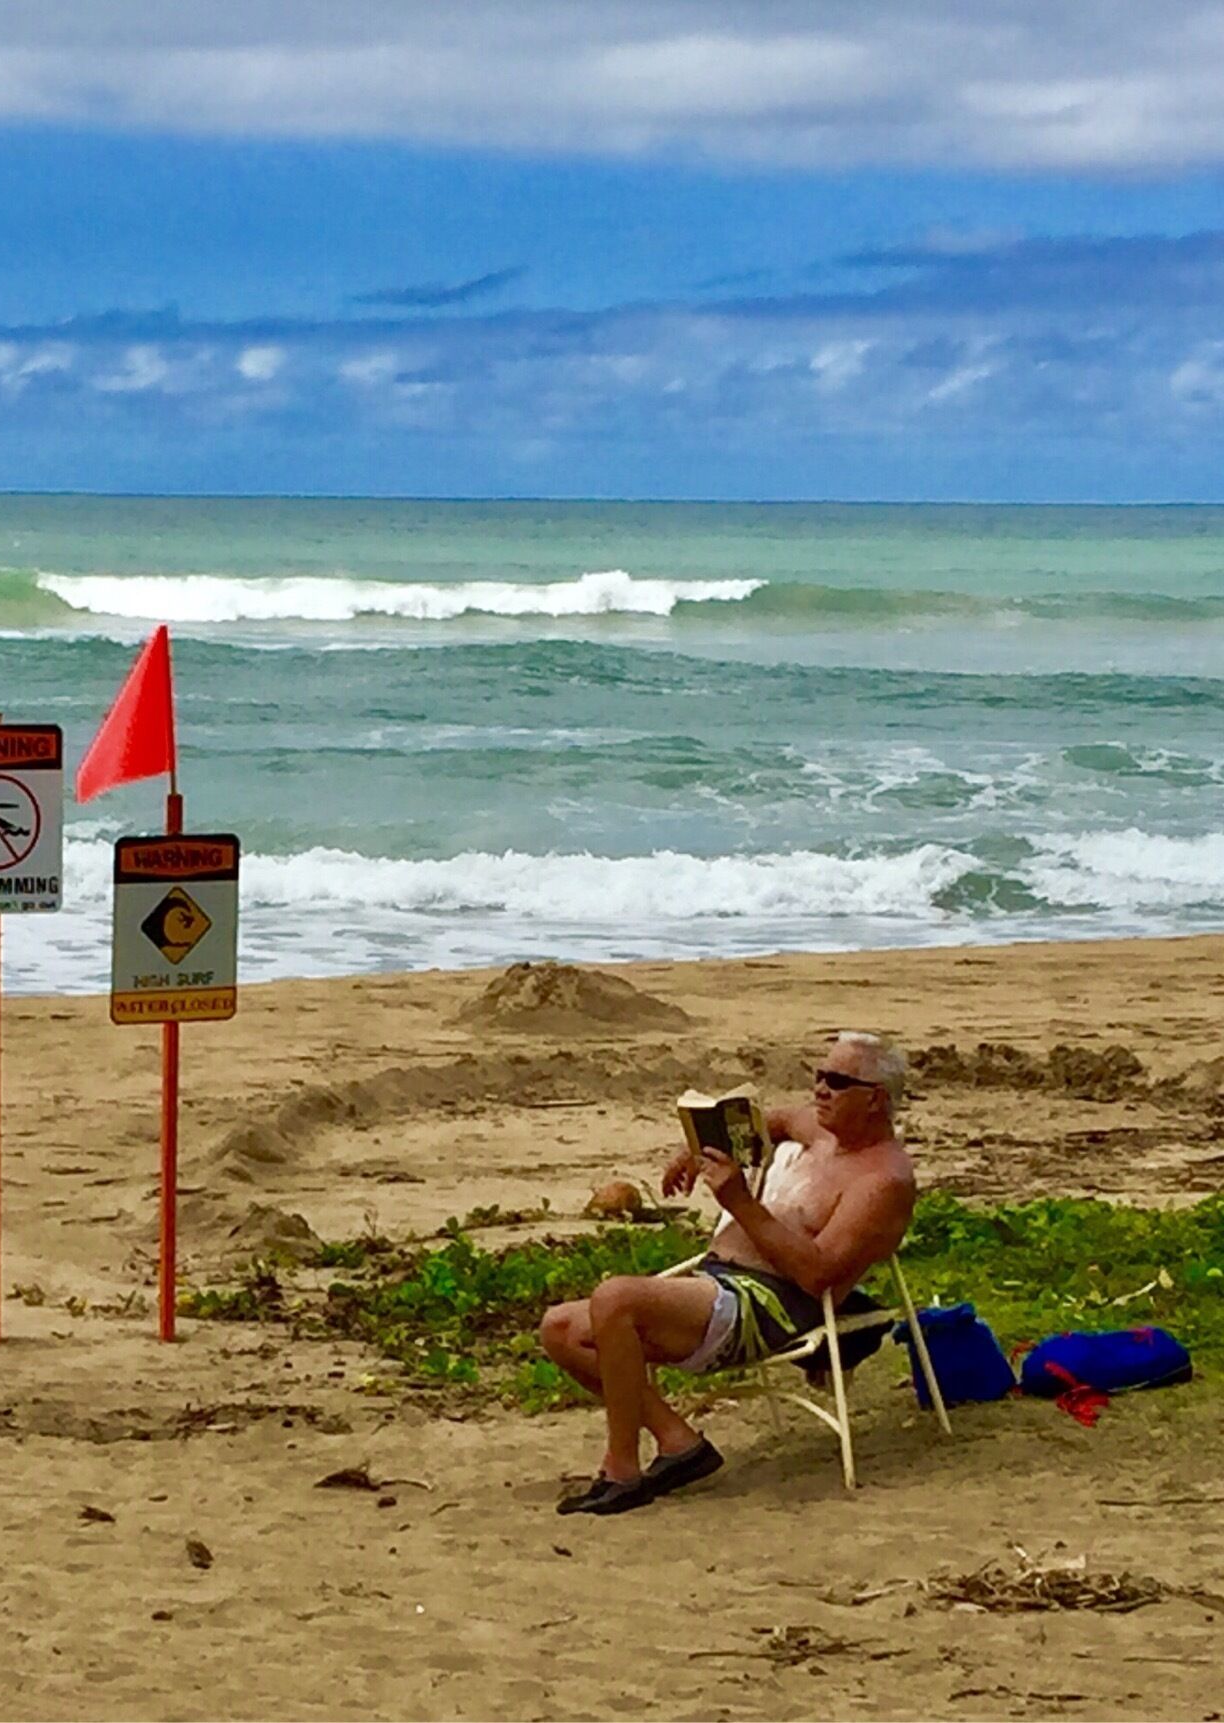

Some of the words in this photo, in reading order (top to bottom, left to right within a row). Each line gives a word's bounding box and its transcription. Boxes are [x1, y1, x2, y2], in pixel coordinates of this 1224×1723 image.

[133, 847, 223, 868] WARNING
[132, 974, 170, 988] HIGH
[177, 971, 214, 986] SURF
